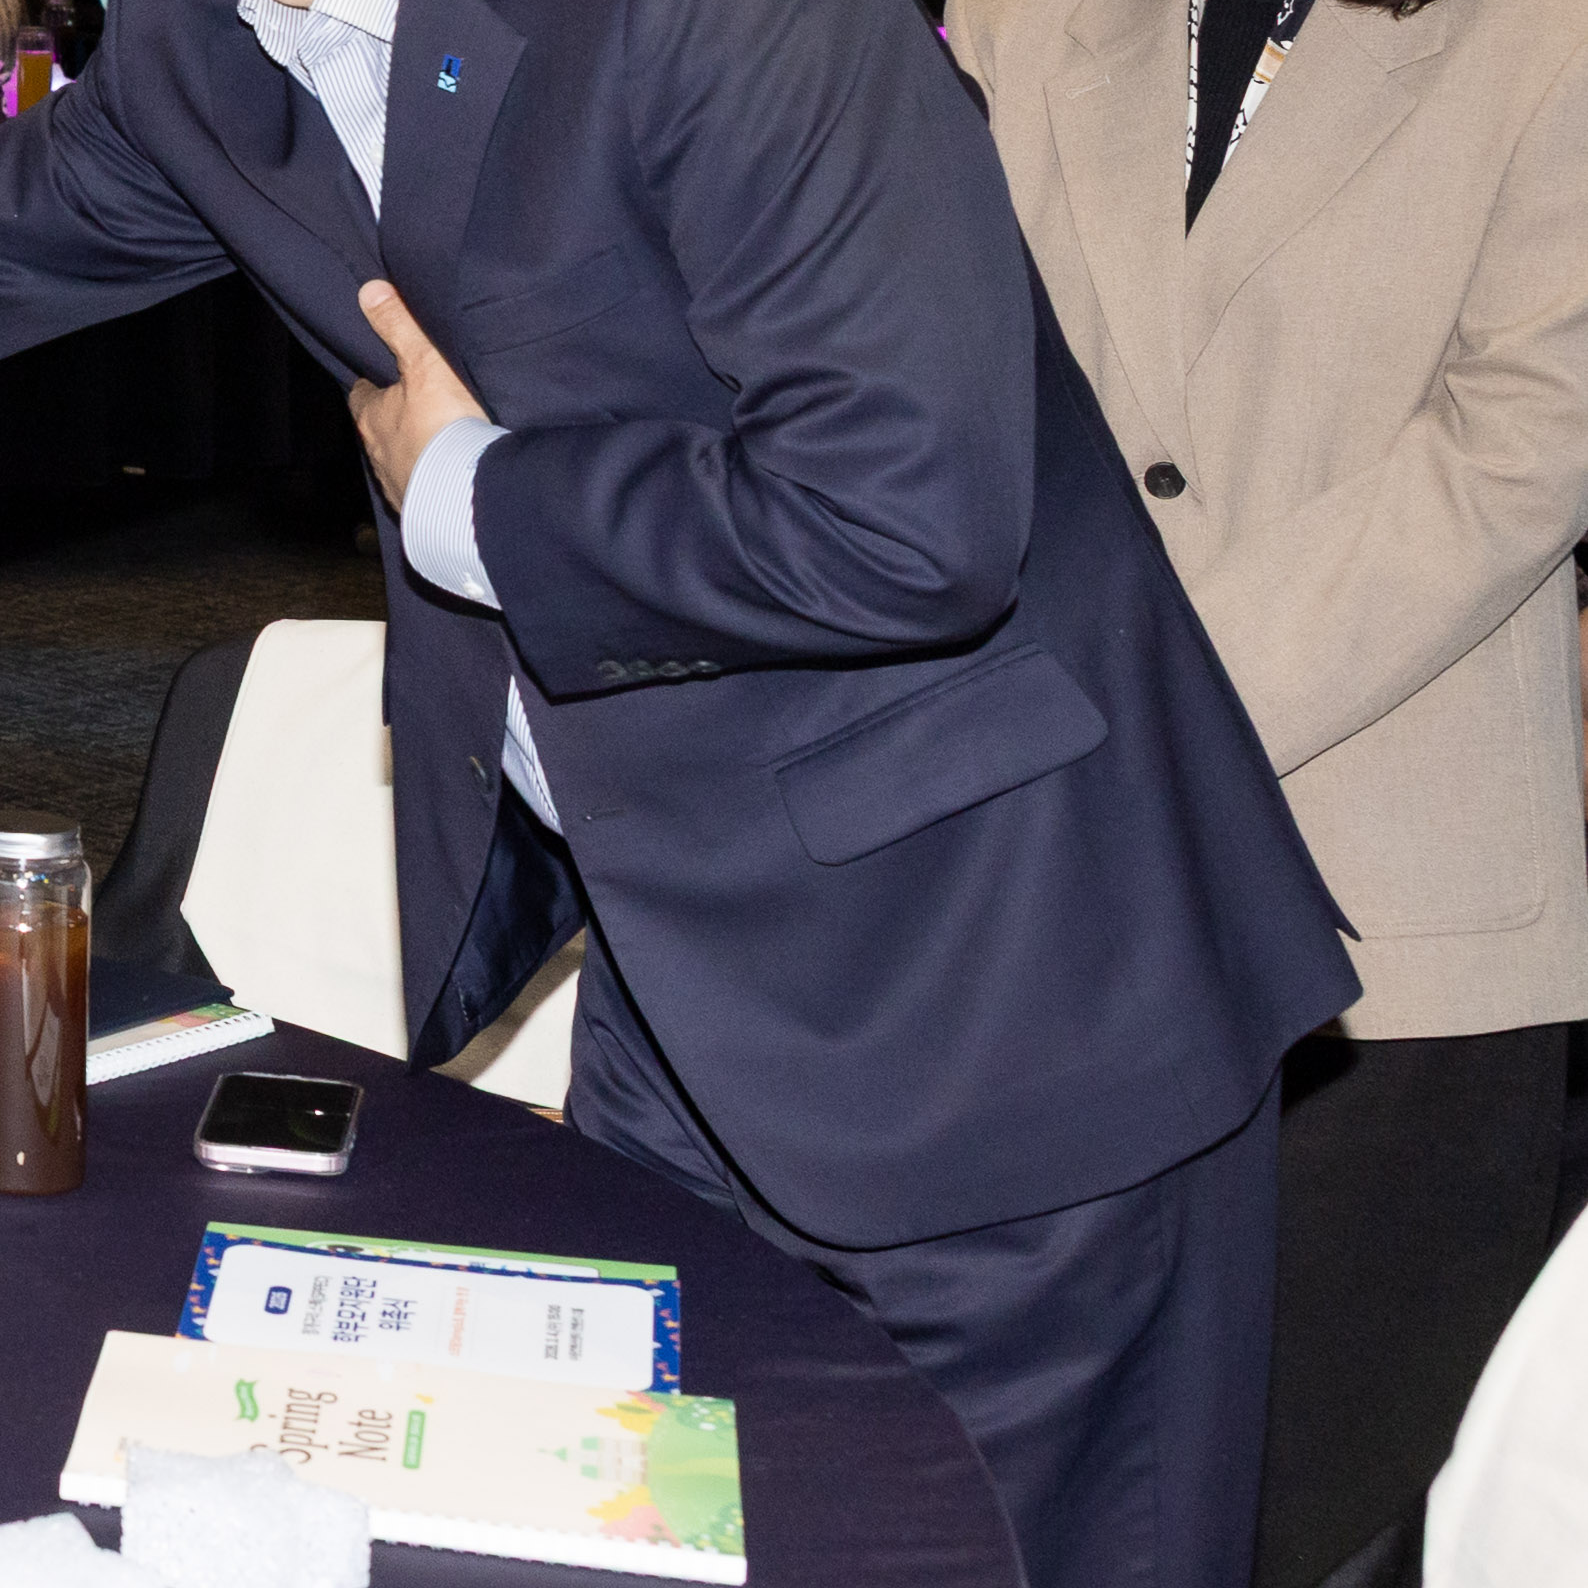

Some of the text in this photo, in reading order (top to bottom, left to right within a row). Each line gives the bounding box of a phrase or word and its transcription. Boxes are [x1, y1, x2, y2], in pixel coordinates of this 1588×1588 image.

[330, 1276, 377, 1343] 학부모지원단
[378, 1296, 418, 1331] 위촉식
[249, 1387, 339, 1465] Spring
[337, 1408, 393, 1462] Note
